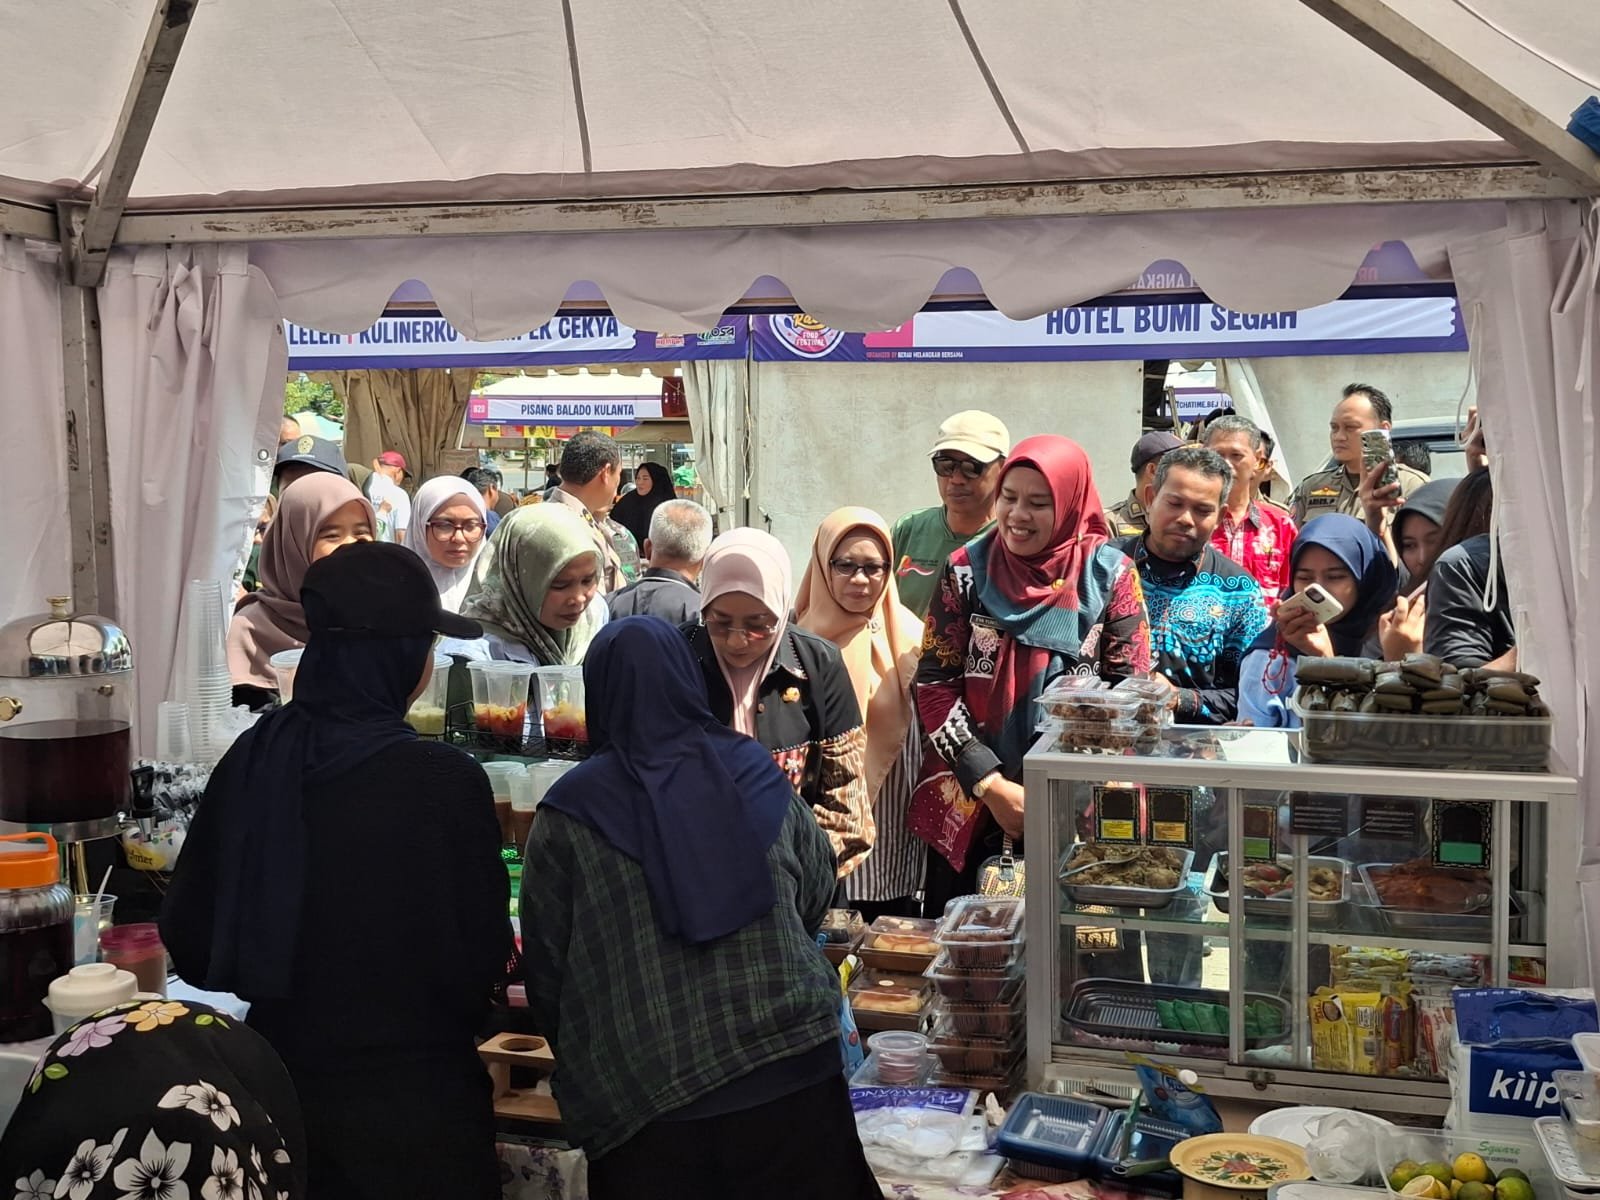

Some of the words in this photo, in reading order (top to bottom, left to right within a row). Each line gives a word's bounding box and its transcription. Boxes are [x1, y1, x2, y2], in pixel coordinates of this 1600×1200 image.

[558, 317, 619, 338] CEKYA
[1046, 307, 1125, 334] HOTEL
[1134, 304, 1200, 333] BUMI
[1210, 304, 1297, 330] SEGAH
[521, 404, 554, 416] PISANG
[556, 404, 591, 416] BALADO
[594, 404, 635, 416] KULANTA
[1488, 1069, 1560, 1109] kiip
